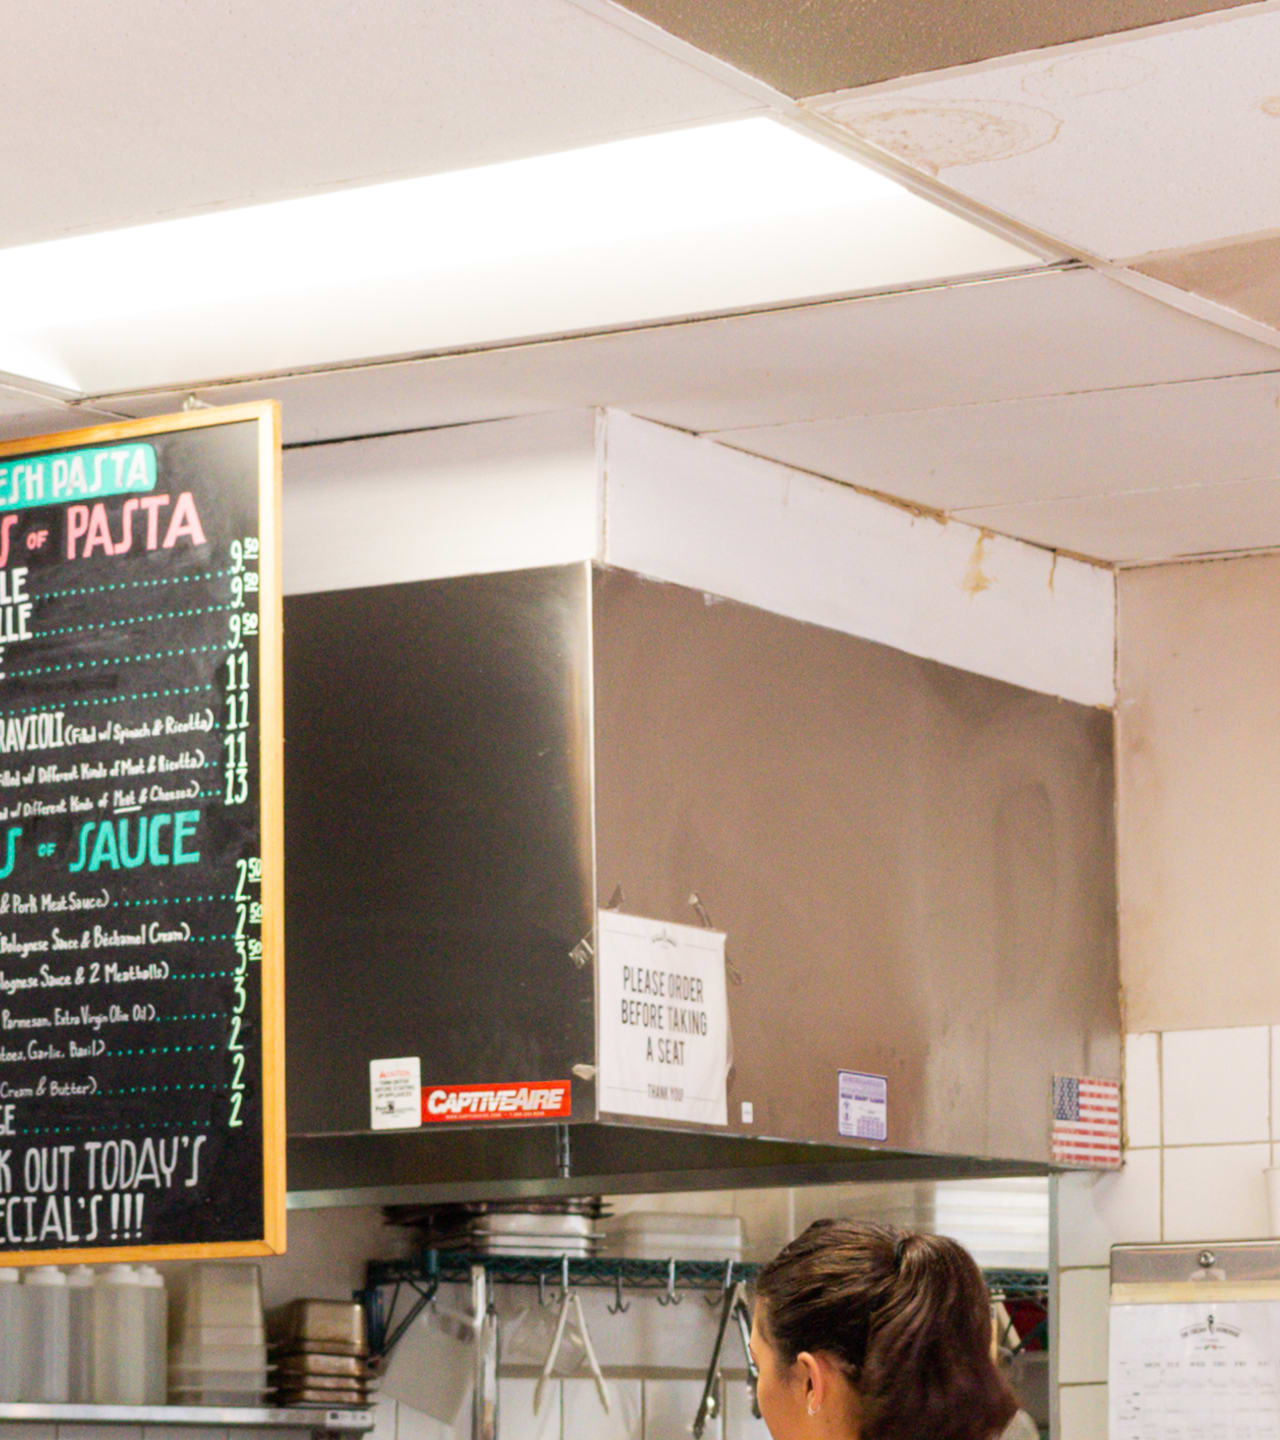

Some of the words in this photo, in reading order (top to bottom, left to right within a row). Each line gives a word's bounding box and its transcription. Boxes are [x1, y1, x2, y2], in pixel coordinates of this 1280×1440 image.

[52, 449, 149, 498] PASTA
[27, 530, 49, 550] OF
[67, 492, 207, 560] PASTA
[226, 650, 250, 691] 11
[225, 691, 250, 730] 11
[224, 731, 248, 768] 11
[224, 768, 248, 806] 13
[37, 842, 57, 857] OF
[69, 810, 201, 873] SAUCE
[0, 891, 10, 914] &
[13, 893, 37, 914] Pork
[41, 893, 68, 912] Meat
[69, 888, 110, 911] Sauce)
[232, 976, 247, 1014] 3
[623, 965, 666, 997] PLEASE
[668, 973, 704, 1004] ORDER
[229, 1015, 244, 1050] 2
[621, 999, 664, 1030] BEFORE
[667, 1006, 707, 1036] TAKING
[646, 1037, 654, 1062] A
[657, 1038, 685, 1066] SEAT
[232, 1053, 246, 1090] 2
[229, 1092, 243, 1127] 2
[427, 1088, 565, 1115] CAPTIVEAIRE
[647, 1084, 668, 1100] THANK
[24, 1144, 72, 1194] OUT
[85, 1135, 207, 1191] TODAY'S
